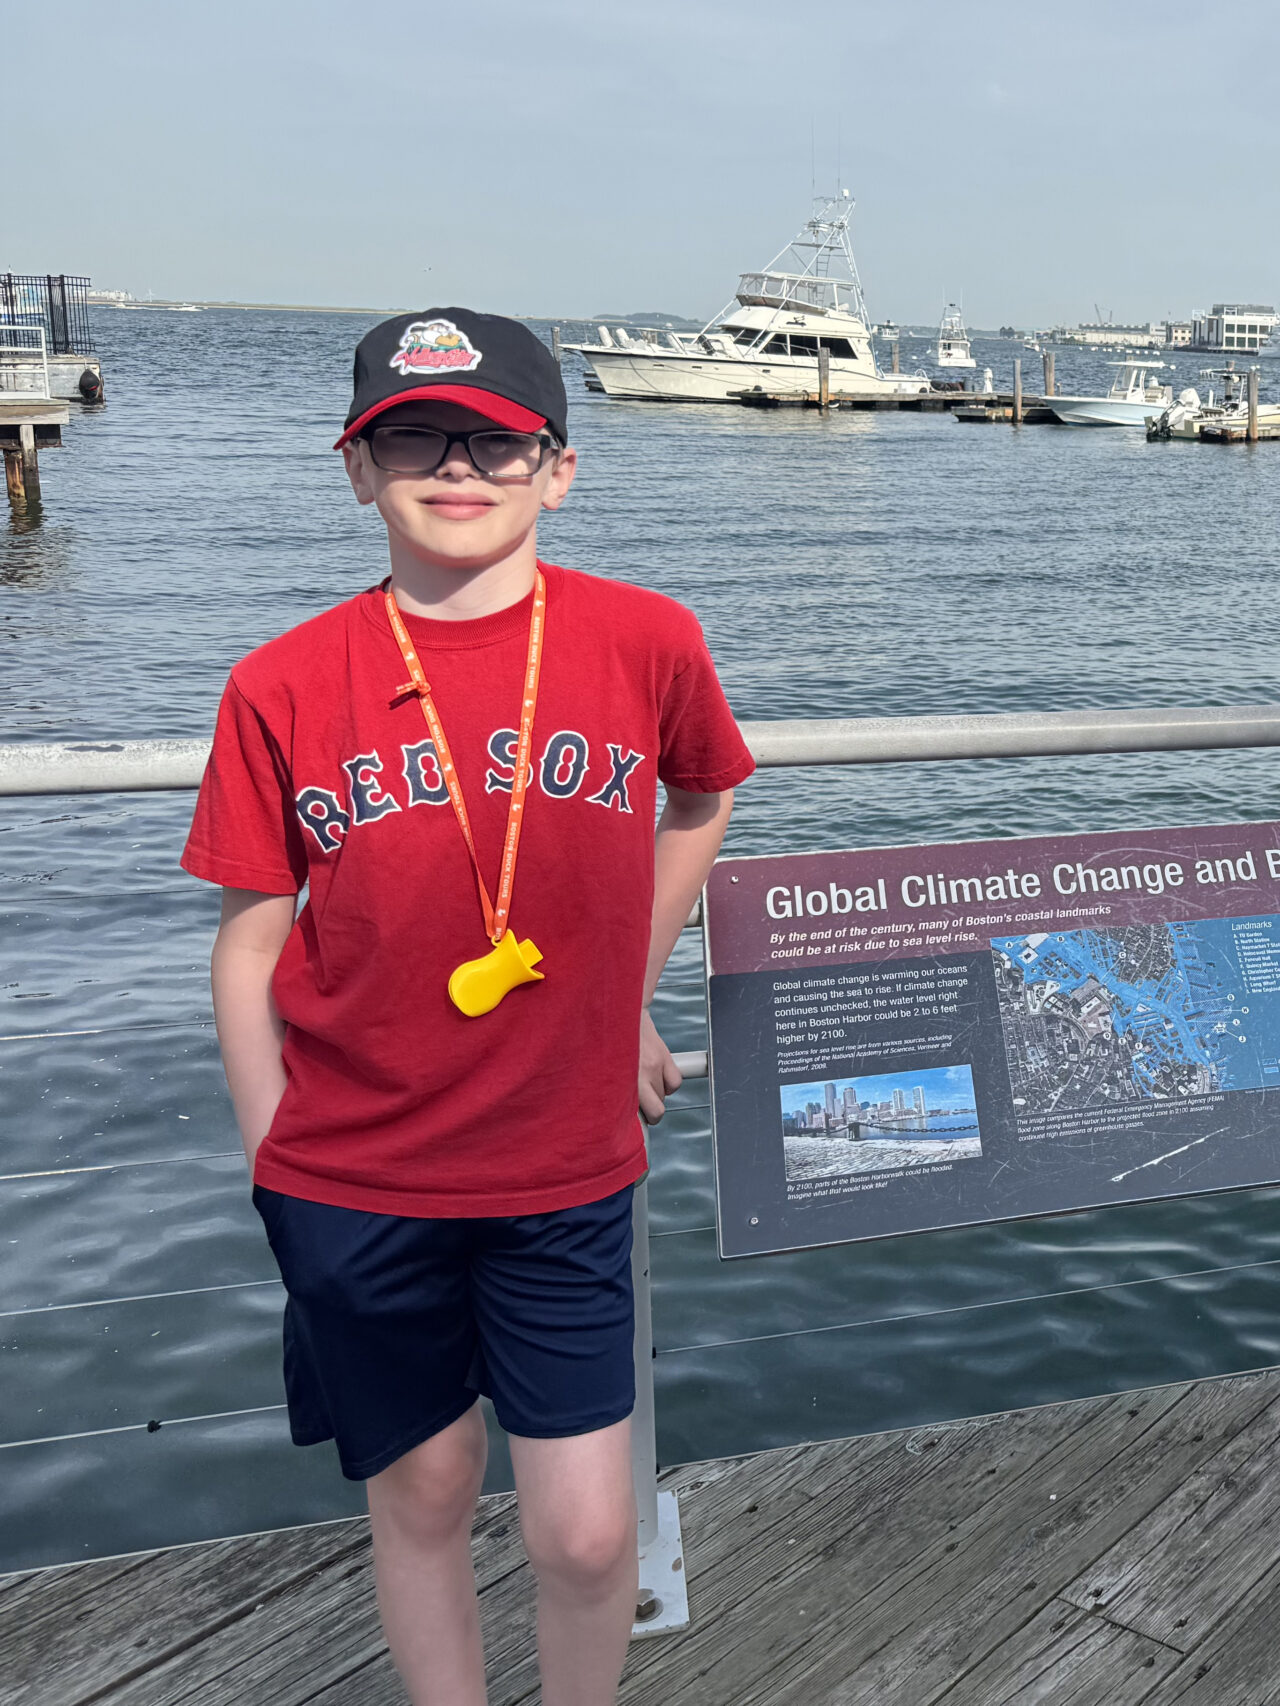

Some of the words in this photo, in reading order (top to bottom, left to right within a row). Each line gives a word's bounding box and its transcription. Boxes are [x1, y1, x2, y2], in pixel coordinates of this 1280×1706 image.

[296, 738, 452, 854] RED
[485, 728, 645, 814] SOX
[516, 770, 524, 792] TOURS
[508, 822, 517, 851] BOSTON
[502, 874, 510, 898] TOURS
[766, 879, 887, 919] Global
[901, 869, 1041, 908] Climate
[1053, 863, 1183, 894] Change
[1195, 851, 1257, 884] and
[770, 932, 785, 946] By
[787, 930, 807, 942] the
[808, 928, 832, 940] end
[833, 926, 846, 938] of
[848, 925, 868, 937] the
[868, 923, 916, 935] century,
[916, 920, 949, 932] many
[950, 916, 962, 928] of
[964, 913, 1012, 927] Boston's
[1012, 909, 1053, 923] coastal
[1054, 904, 1110, 920] landmarks
[1232, 921, 1272, 930] Landmarks
[772, 945, 803, 959] could
[805, 944, 821, 956] be
[822, 943, 836, 954] at
[837, 940, 861, 953] risk
[862, 939, 885, 951] due
[887, 938, 900, 949] to
[901, 937, 922, 947] sea
[924, 932, 951, 945] level
[952, 931, 979, 943] rise.
[773, 979, 800, 991] Global
[803, 977, 835, 988] climate
[837, 974, 869, 985] change
[872, 972, 879, 982] is
[881, 968, 919, 981] warming
[920, 968, 935, 977] our
[937, 965, 967, 976] oceans
[774, 992, 790, 1004] and
[793, 990, 827, 1002] causing
[830, 988, 844, 998] the
[846, 988, 862, 997] sea
[864, 986, 873, 995] to
[875, 984, 893, 994] rise.
[896, 982, 901, 992] If
[904, 980, 935, 992] climate
[937, 978, 968, 989] change
[775, 1005, 818, 1017] continues
[820, 998, 871, 1012] unchecked,
[873, 997, 887, 1007] the
[889, 995, 913, 1006] water
[916, 991, 936, 1003] level
[938, 990, 958, 1002] right
[776, 1020, 796, 1030] here
[798, 1018, 806, 1028] in
[809, 1016, 840, 1027] Boston
[842, 1012, 872, 1024] Harbor
[874, 1008, 898, 1020] could
[900, 1008, 911, 1018] be
[913, 1006, 919, 1016] 2
[921, 1006, 930, 1016] to
[932, 1004, 938, 1015] 6
[940, 1003, 957, 1014] feet
[777, 1032, 805, 1045] higher
[807, 1030, 819, 1042] by
[820, 1028, 847, 1040] 2100.
[1046, 1114, 1073, 1122] compares
[1103, 1107, 1123, 1115] Federal
[1123, 1105, 1152, 1113] Emergency
[1152, 1100, 1186, 1109] Management
[1206, 1095, 1224, 1104] (FEMA)
[1117, 1113, 1140, 1123] projected
[1189, 1105, 1213, 1114] assuming
[795, 1182, 813, 1191] 2100,
[814, 1181, 830, 1189] parts
[904, 1168, 920, 1176] could
